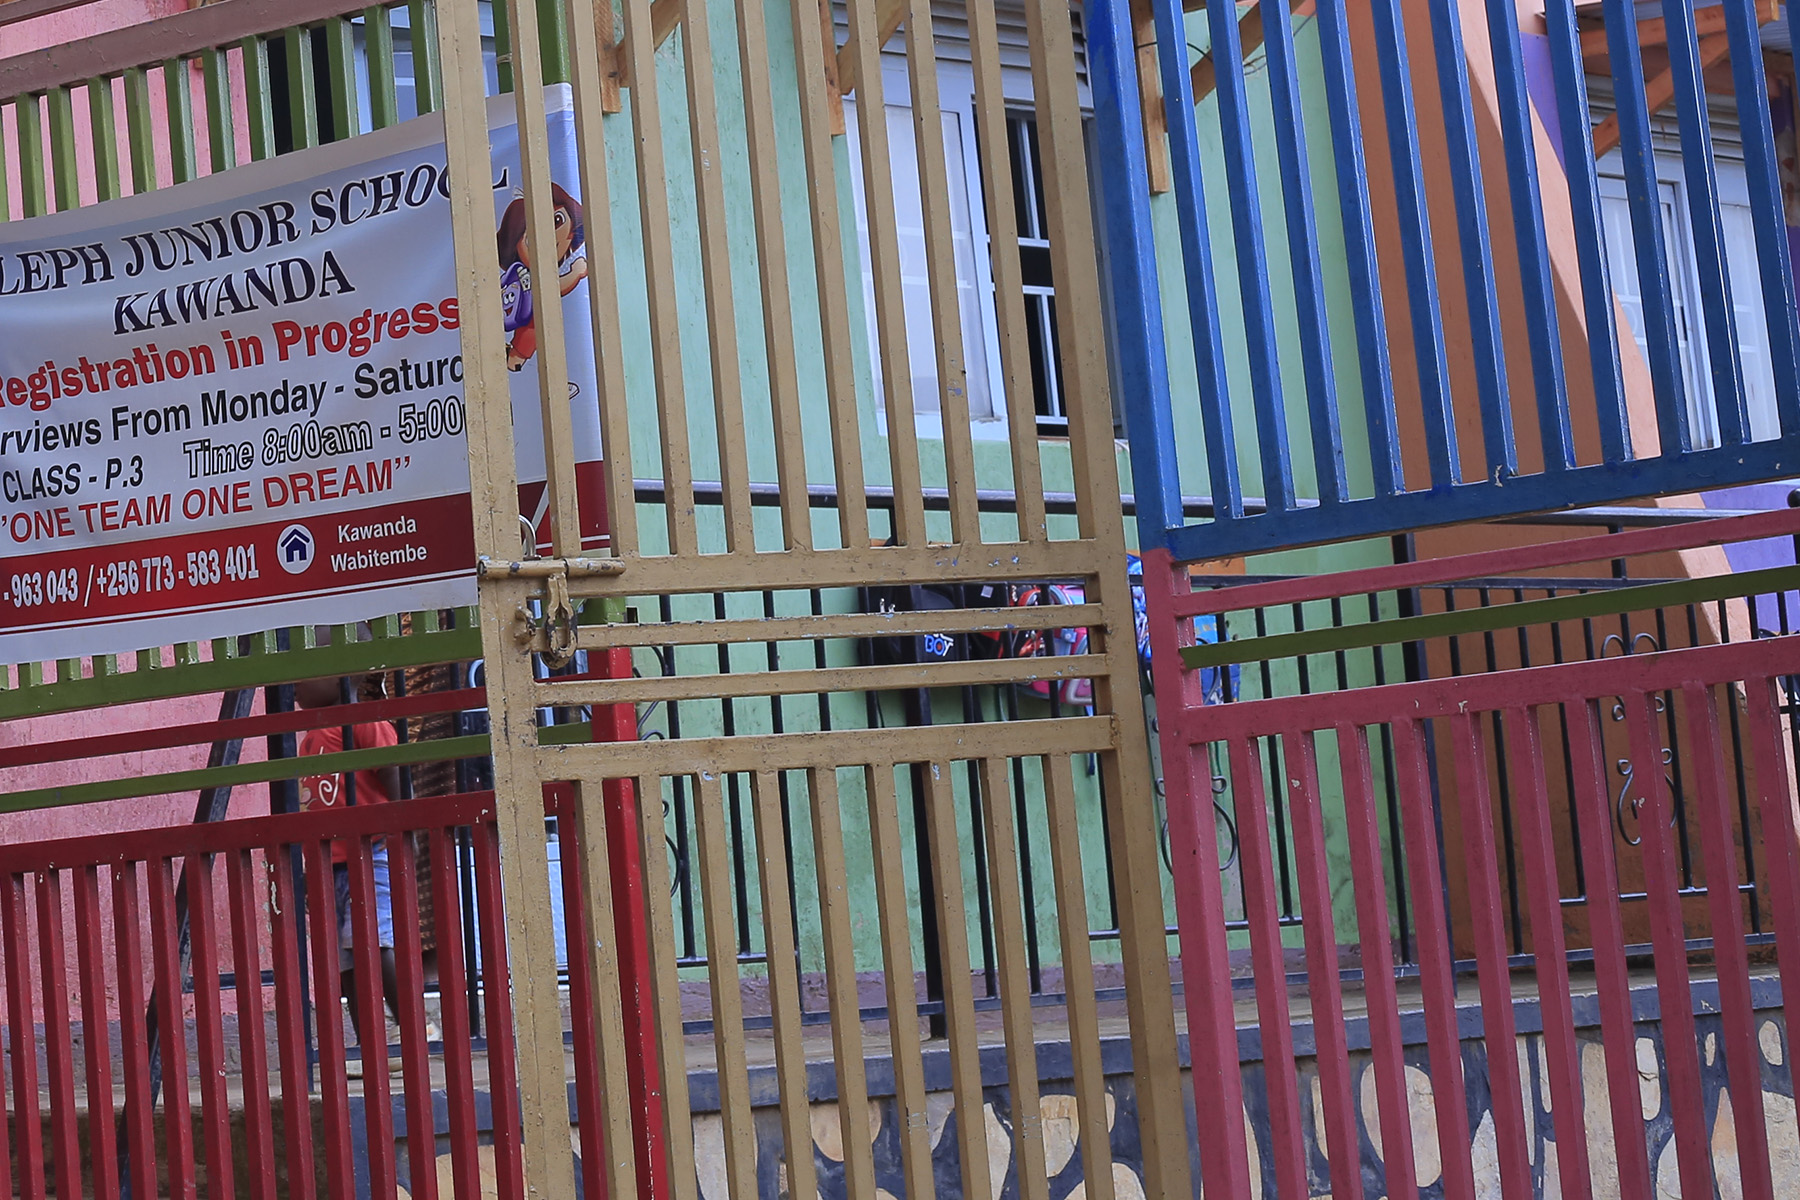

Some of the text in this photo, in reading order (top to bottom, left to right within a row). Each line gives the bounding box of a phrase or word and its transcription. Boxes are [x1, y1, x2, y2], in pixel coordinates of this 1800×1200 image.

[125, 200, 302, 278] JUNIOR
[113, 250, 356, 335] KAWANDA
[220, 329, 264, 373] in
[272, 297, 461, 362] Progress
[111, 403, 190, 441] From
[201, 379, 327, 428] Monday
[2, 462, 82, 504] CLASS
[104, 455, 145, 490] P.3
[183, 438, 254, 479] Time
[261, 419, 373, 467] 8:00am
[78, 493, 172, 534] TEAM
[182, 480, 254, 521] ONE
[337, 515, 417, 545] Kawanda
[11, 572, 44, 608] 963
[46, 567, 79, 605] 043
[142, 557, 174, 593] 773
[187, 550, 221, 586] 583
[225, 543, 259, 581] 401
[330, 544, 428, 573] Wabitembe
